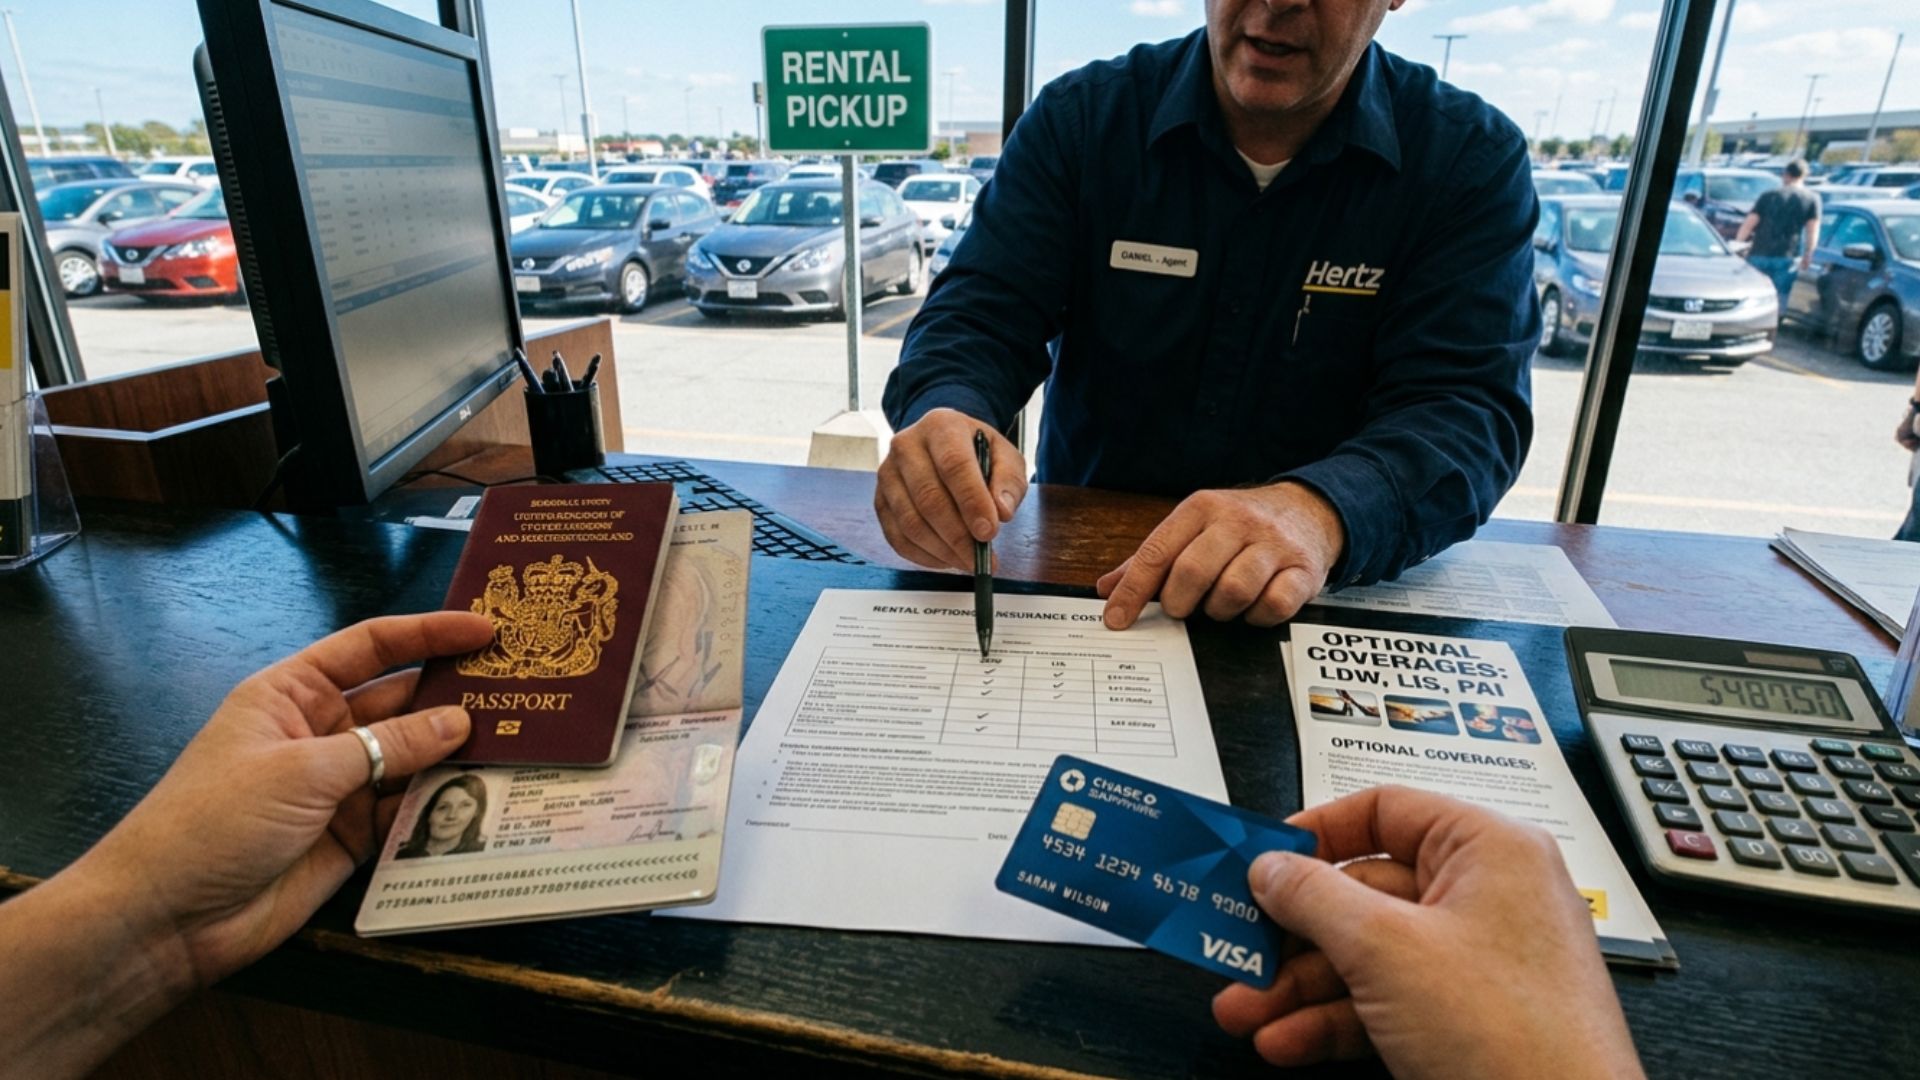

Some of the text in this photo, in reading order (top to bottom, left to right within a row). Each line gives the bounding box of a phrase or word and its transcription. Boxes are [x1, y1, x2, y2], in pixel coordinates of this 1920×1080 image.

[782, 50, 911, 84] RENTAL
[787, 94, 907, 128] PICKUP
[1161, 256, 1187, 267] Agent
[1305, 260, 1384, 288] Hertz
[873, 605, 919, 615] RENTAL
[1322, 632, 1481, 660] OPTIONAL
[1307, 646, 1509, 679] COVERAGES:
[1320, 666, 1505, 697] LDW, LIS, PAI
[461, 692, 572, 711] PASSPORT
[1331, 737, 1538, 771] OPTIONAL COVERAGES:
[1684, 833, 1829, 864] C 0 00
[1043, 834, 1086, 861] 4534
[1095, 853, 1141, 880] 1234
[1152, 872, 1200, 902] 5678
[1062, 886, 1110, 913] WILSON
[1199, 931, 1264, 976] VISA
